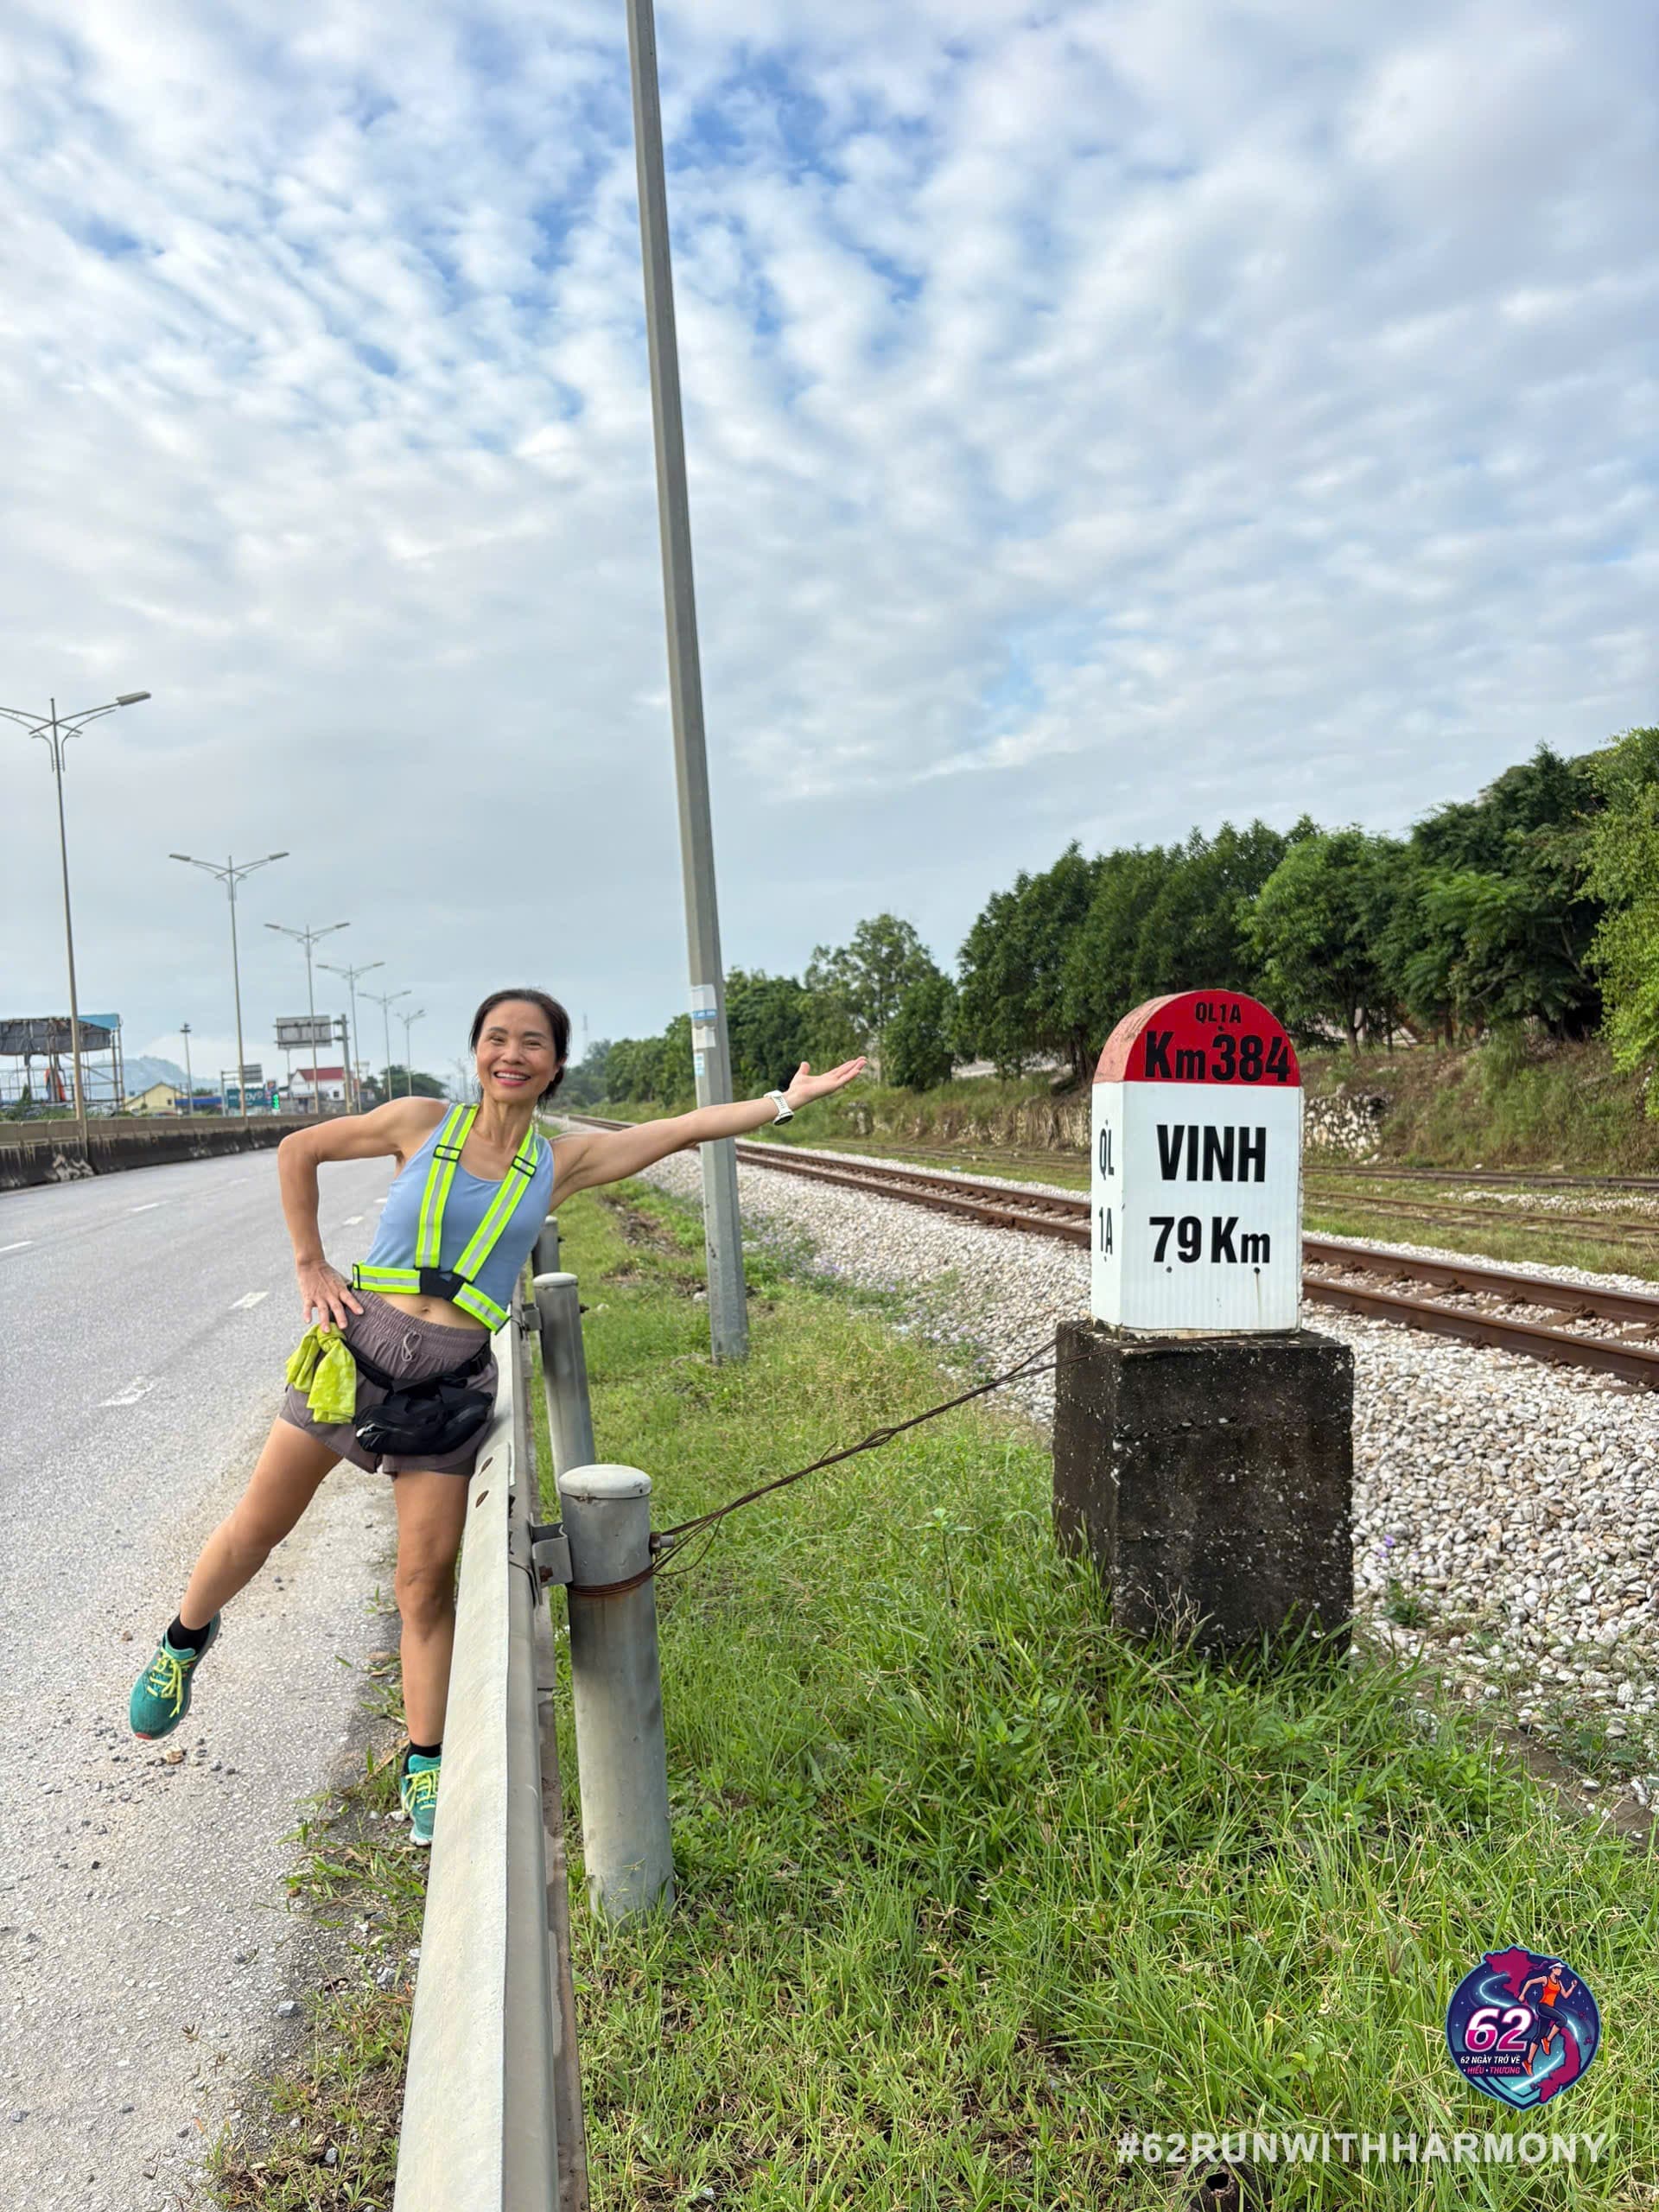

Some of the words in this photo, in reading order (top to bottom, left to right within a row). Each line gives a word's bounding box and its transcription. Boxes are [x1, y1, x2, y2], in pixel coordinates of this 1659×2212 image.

[1195, 1001, 1242, 1023] QL1A
[1099, 1128, 1115, 1180] QL
[1156, 1124, 1267, 1182] VINH
[1098, 1206, 1113, 1255] 1A
[1149, 1216, 1202, 1263] 79
[1211, 1217, 1270, 1263] Km
